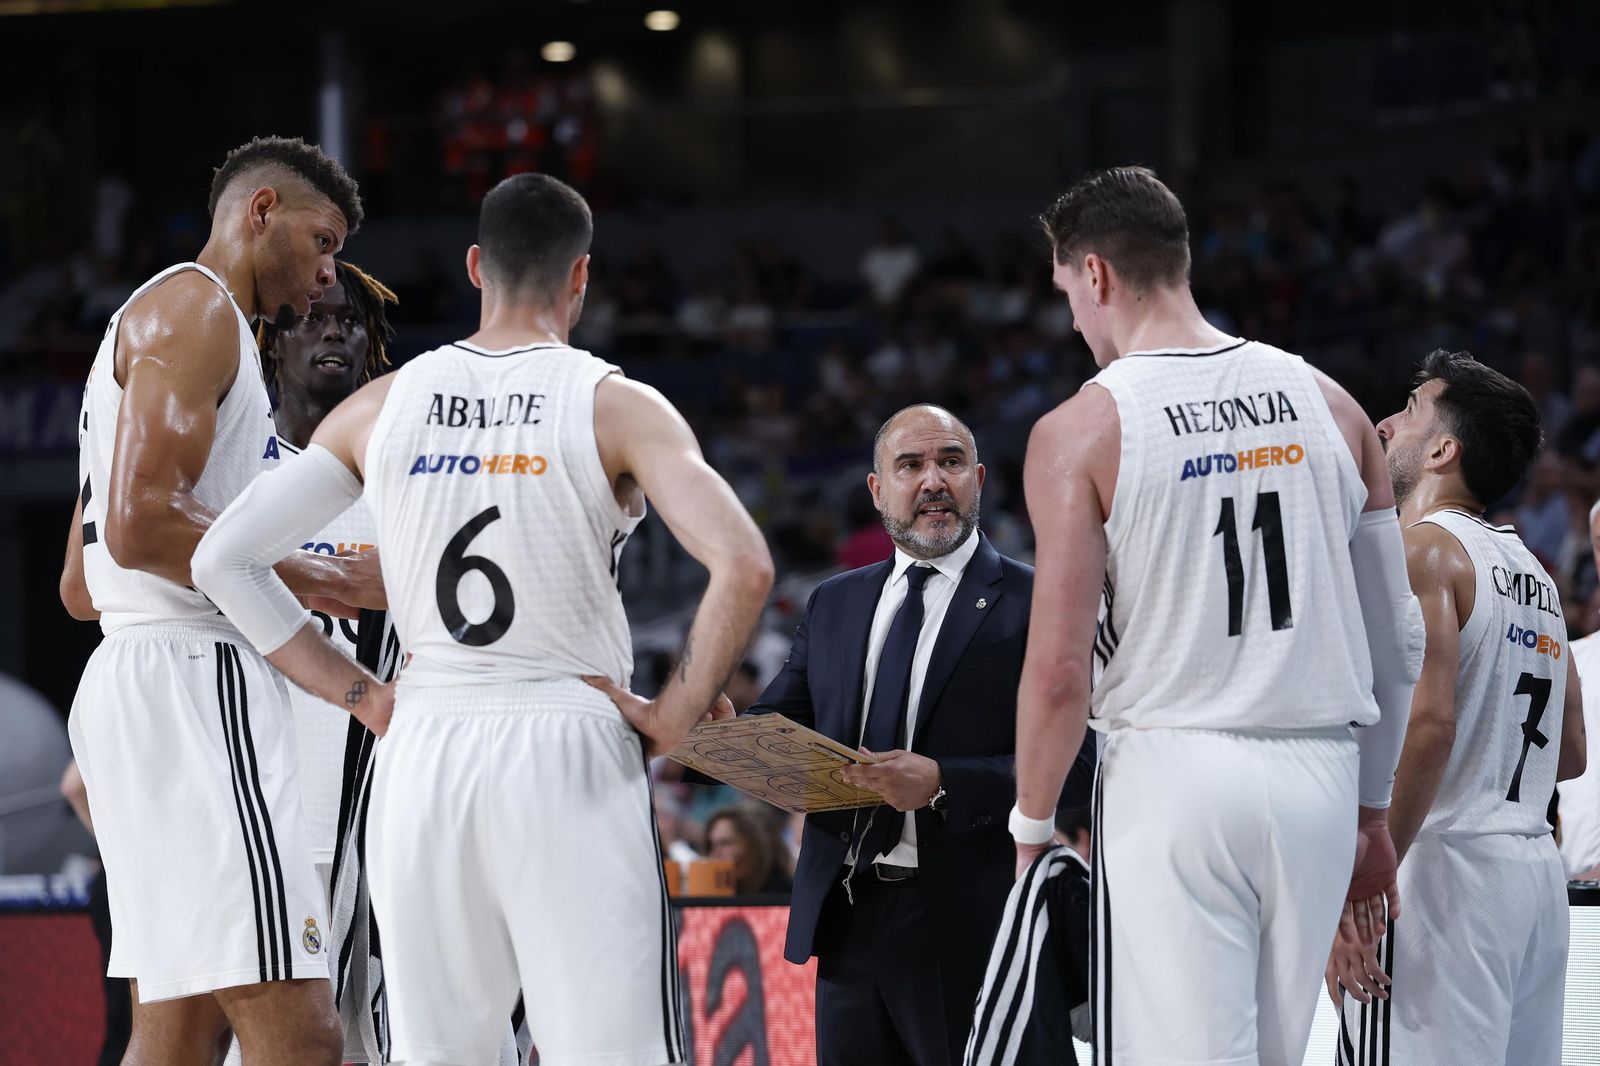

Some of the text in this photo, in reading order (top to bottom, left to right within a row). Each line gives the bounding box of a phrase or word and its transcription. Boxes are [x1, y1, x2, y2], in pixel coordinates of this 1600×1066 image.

[426, 393, 546, 429] ABALDE
[1163, 391, 1299, 436] HEZONJA
[409, 453, 548, 476] AUTOHERO
[1180, 444, 1305, 481] AUTOHERO
[436, 505, 515, 647] 6
[1212, 490, 1294, 637] 11
[1505, 671, 1553, 803] 7
